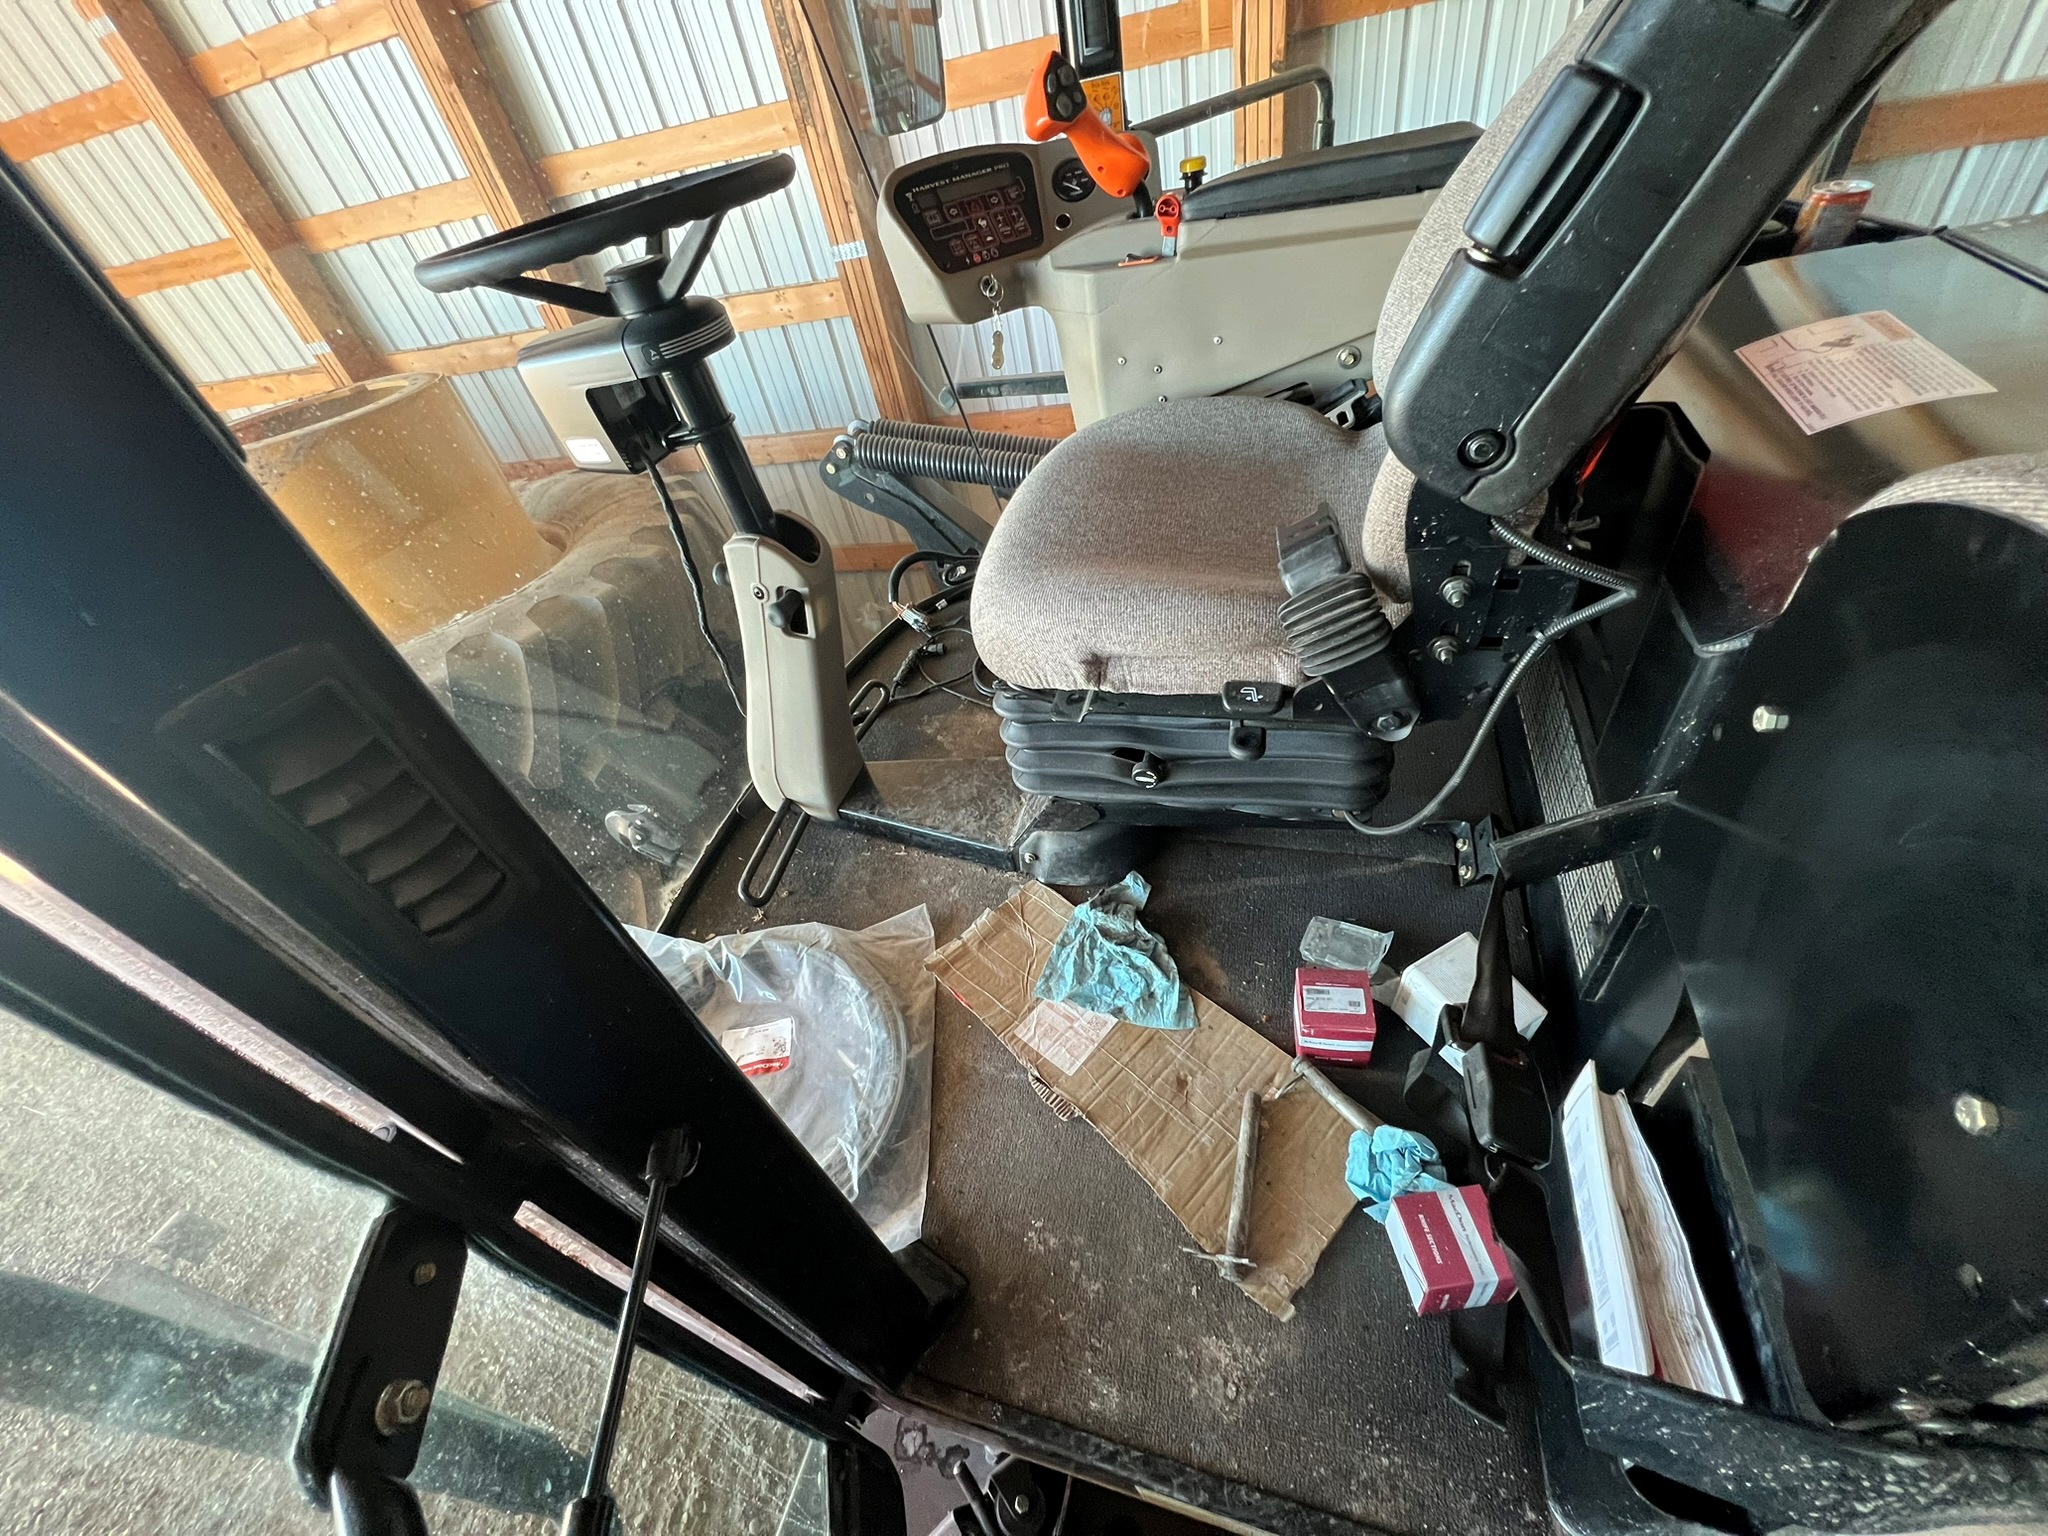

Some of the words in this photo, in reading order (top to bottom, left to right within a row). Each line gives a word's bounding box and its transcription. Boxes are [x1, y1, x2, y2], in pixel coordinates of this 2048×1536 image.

[912, 178, 950, 193] HARVEST
[952, 167, 992, 182] MANAGER
[1448, 1194, 1467, 1232] MacDon
[1425, 1233, 1444, 1265] SECTIONS
